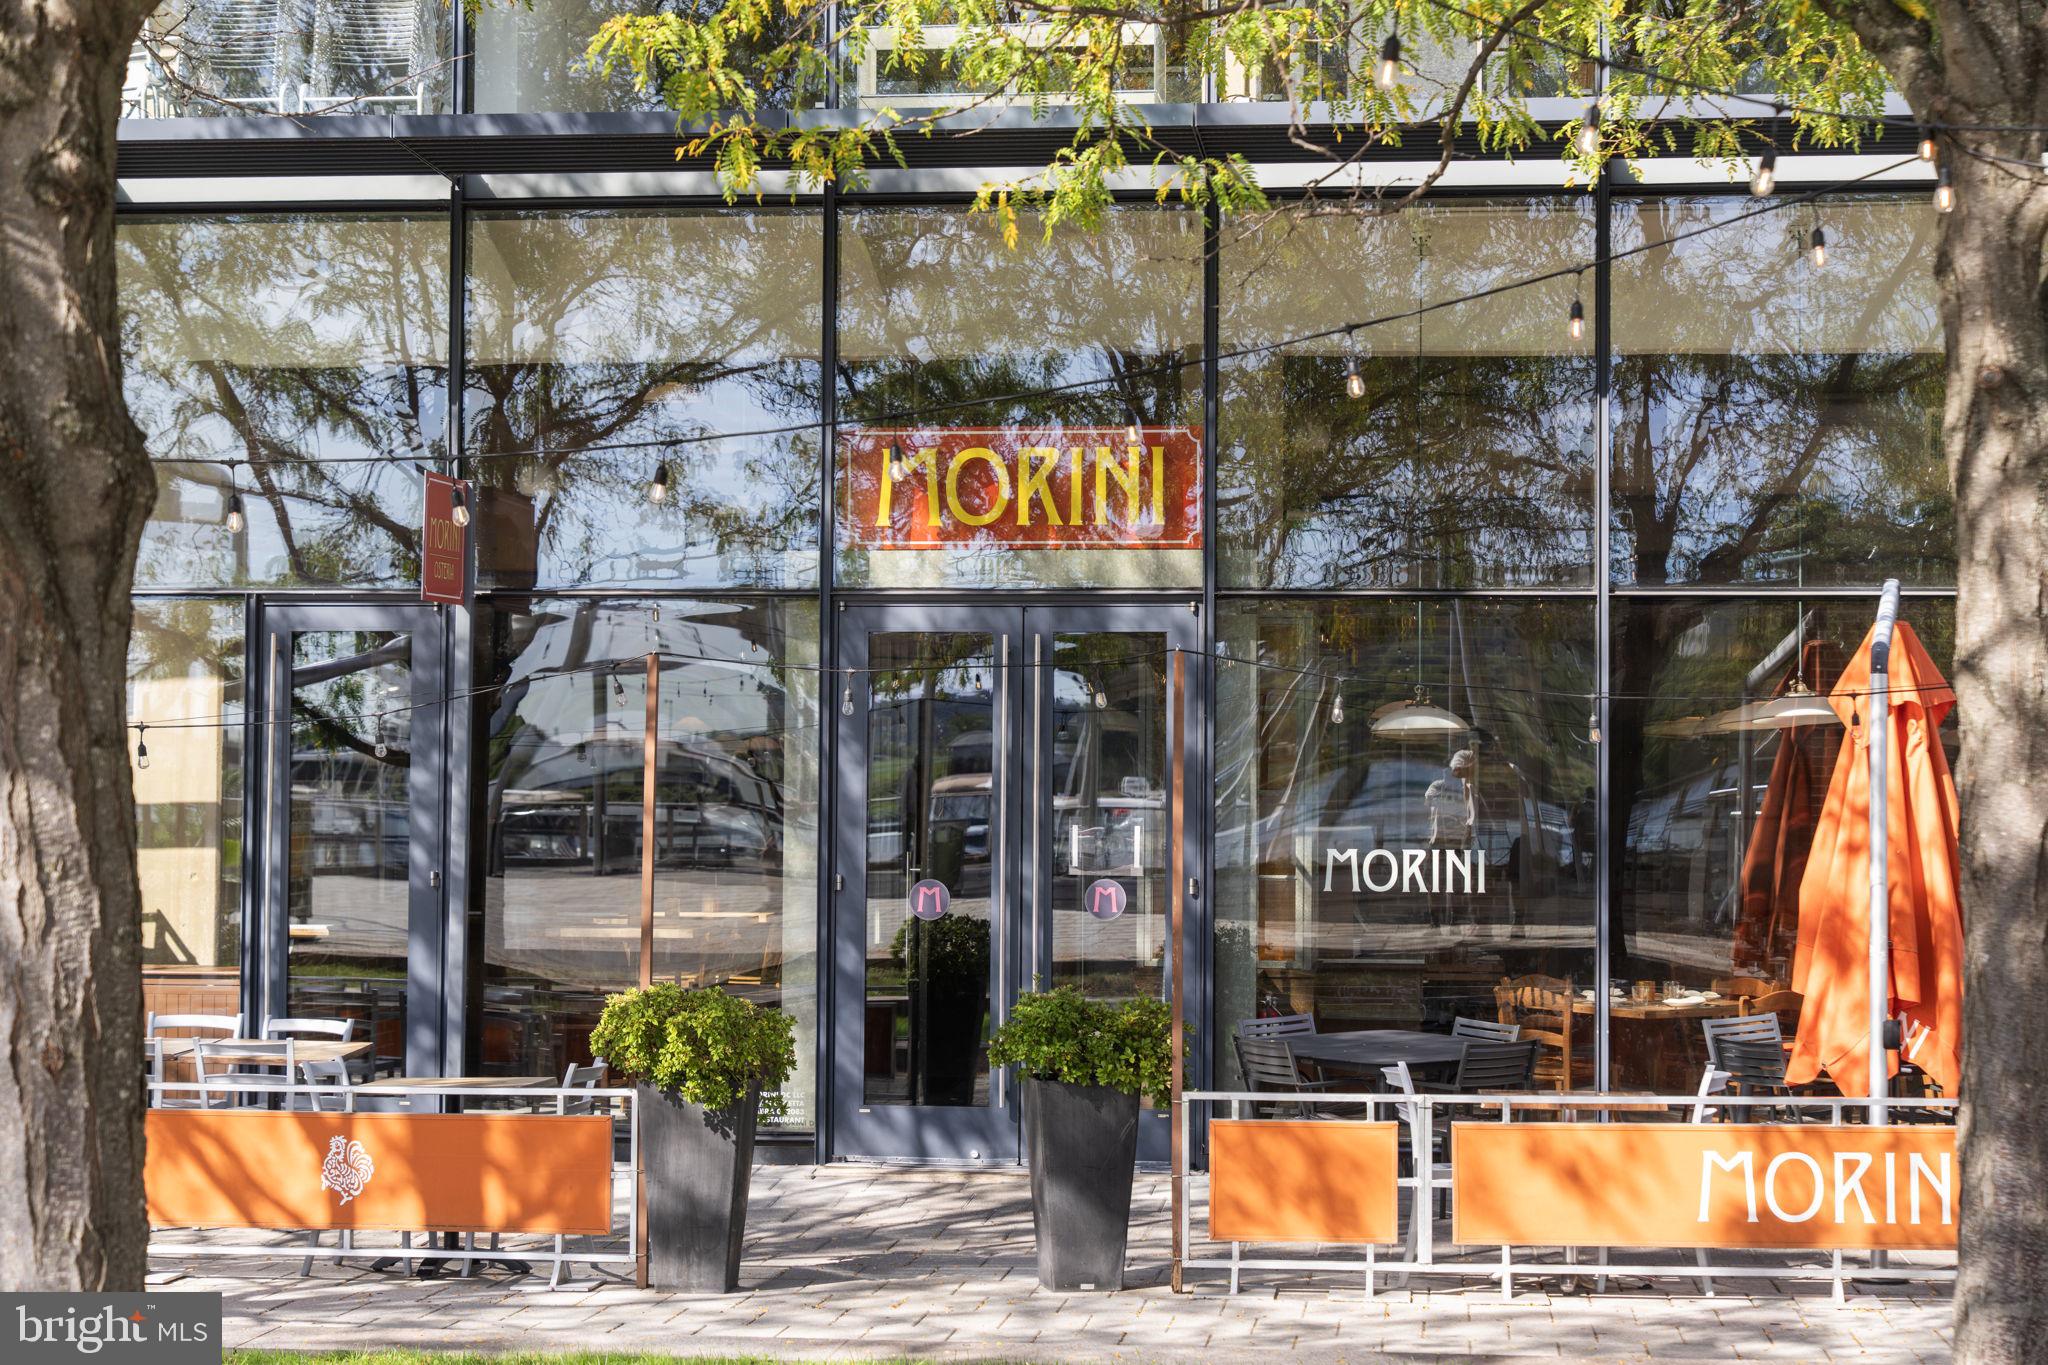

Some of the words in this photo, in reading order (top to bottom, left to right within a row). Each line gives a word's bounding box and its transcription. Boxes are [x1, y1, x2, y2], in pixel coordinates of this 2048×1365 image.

[876, 446, 1165, 526] MORINI
[430, 517, 461, 552] MORINI
[434, 561, 455, 580] OSTERIA
[1323, 848, 1486, 893] MORINI
[917, 886, 941, 913] M
[1093, 886, 1117, 913] M
[1697, 1150, 1952, 1224] MORIN
